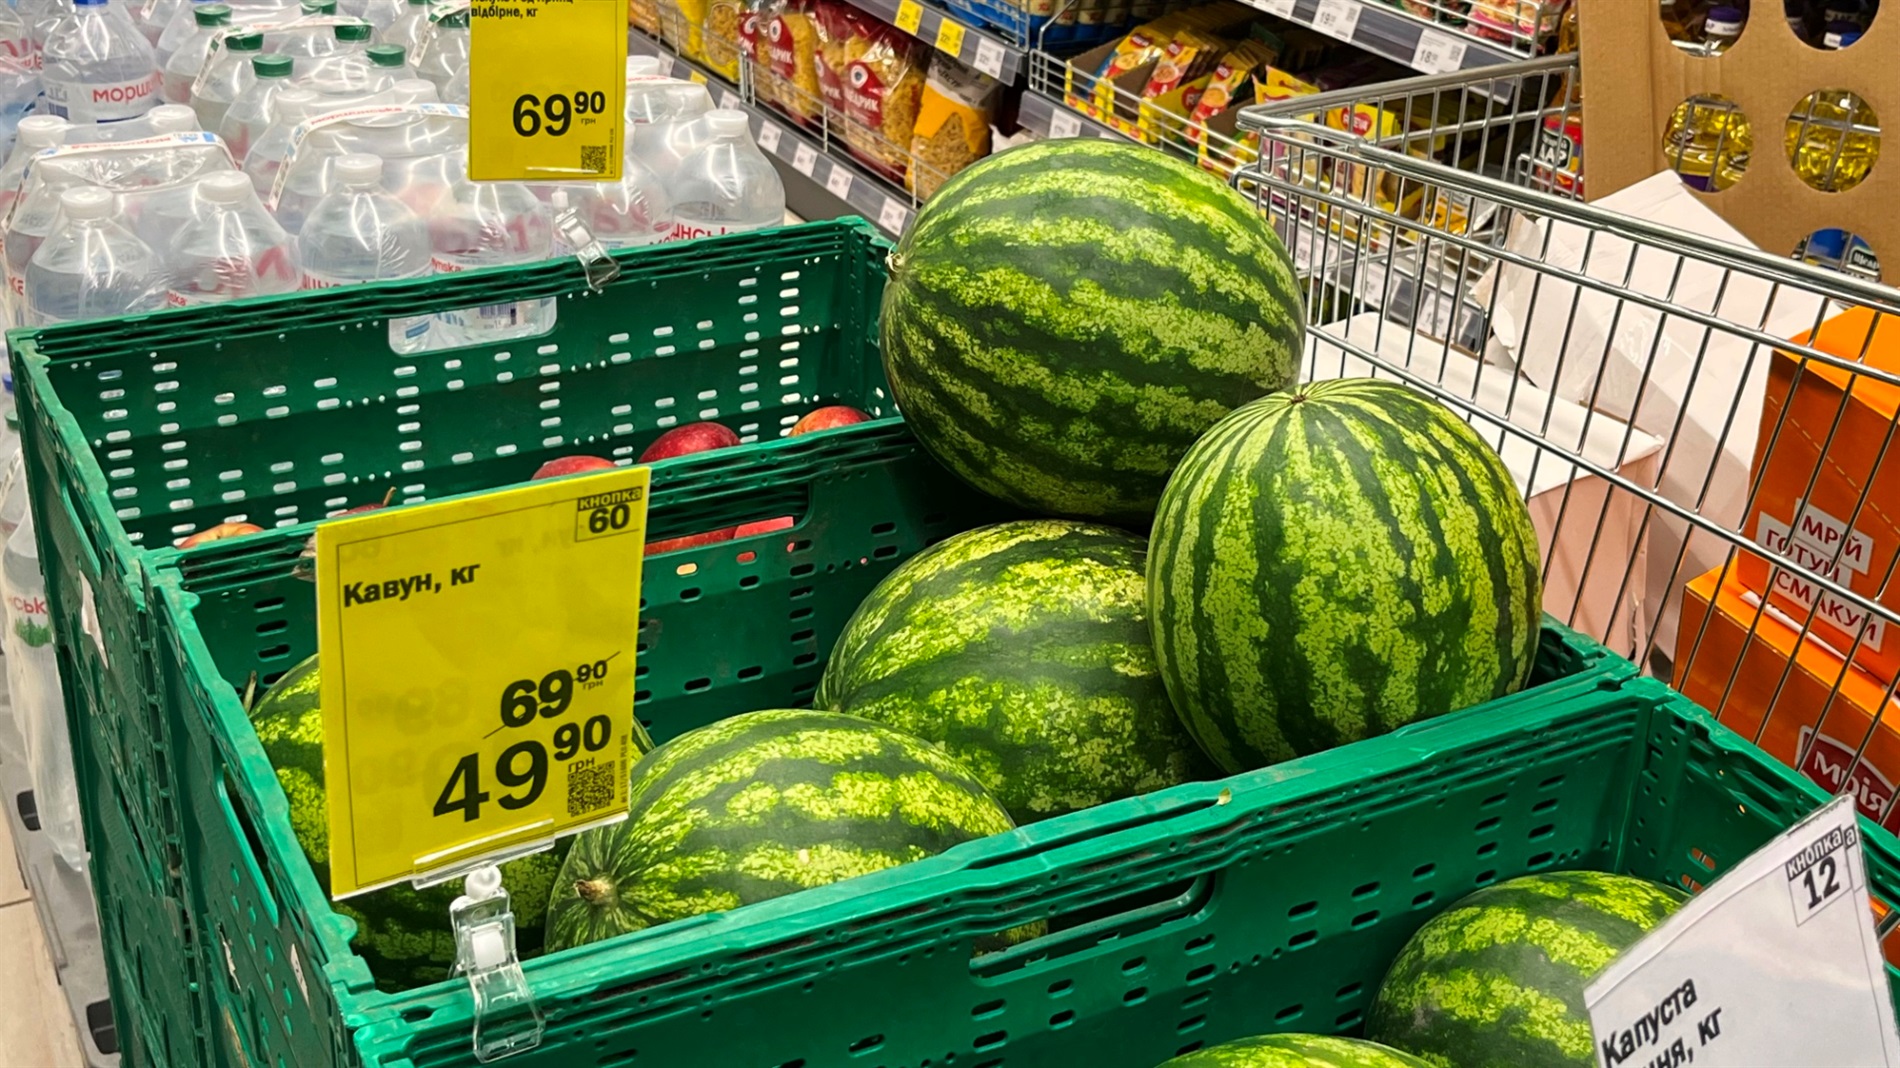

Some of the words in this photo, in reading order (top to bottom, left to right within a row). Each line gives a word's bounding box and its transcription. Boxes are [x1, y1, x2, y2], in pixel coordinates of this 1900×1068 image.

[471, 6, 524, 20] відбірне,
[526, 9, 538, 17] кг
[512, 94, 572, 137] 69
[574, 91, 606, 114] 90
[581, 117, 596, 126] грн
[580, 488, 641, 509] кнопка
[589, 503, 630, 534] 60
[344, 573, 442, 608] Кавун,
[451, 563, 481, 587] кг
[501, 669, 573, 728] 69
[577, 660, 607, 683] 90
[582, 680, 604, 690] грн
[433, 739, 549, 823] 49
[553, 714, 611, 762] 90
[568, 757, 595, 774] грн
[1787, 829, 1842, 879] кнопка
[1803, 856, 1840, 910] 12
[1602, 978, 1697, 1068] Капуста
[1697, 1007, 1722, 1047] кг
